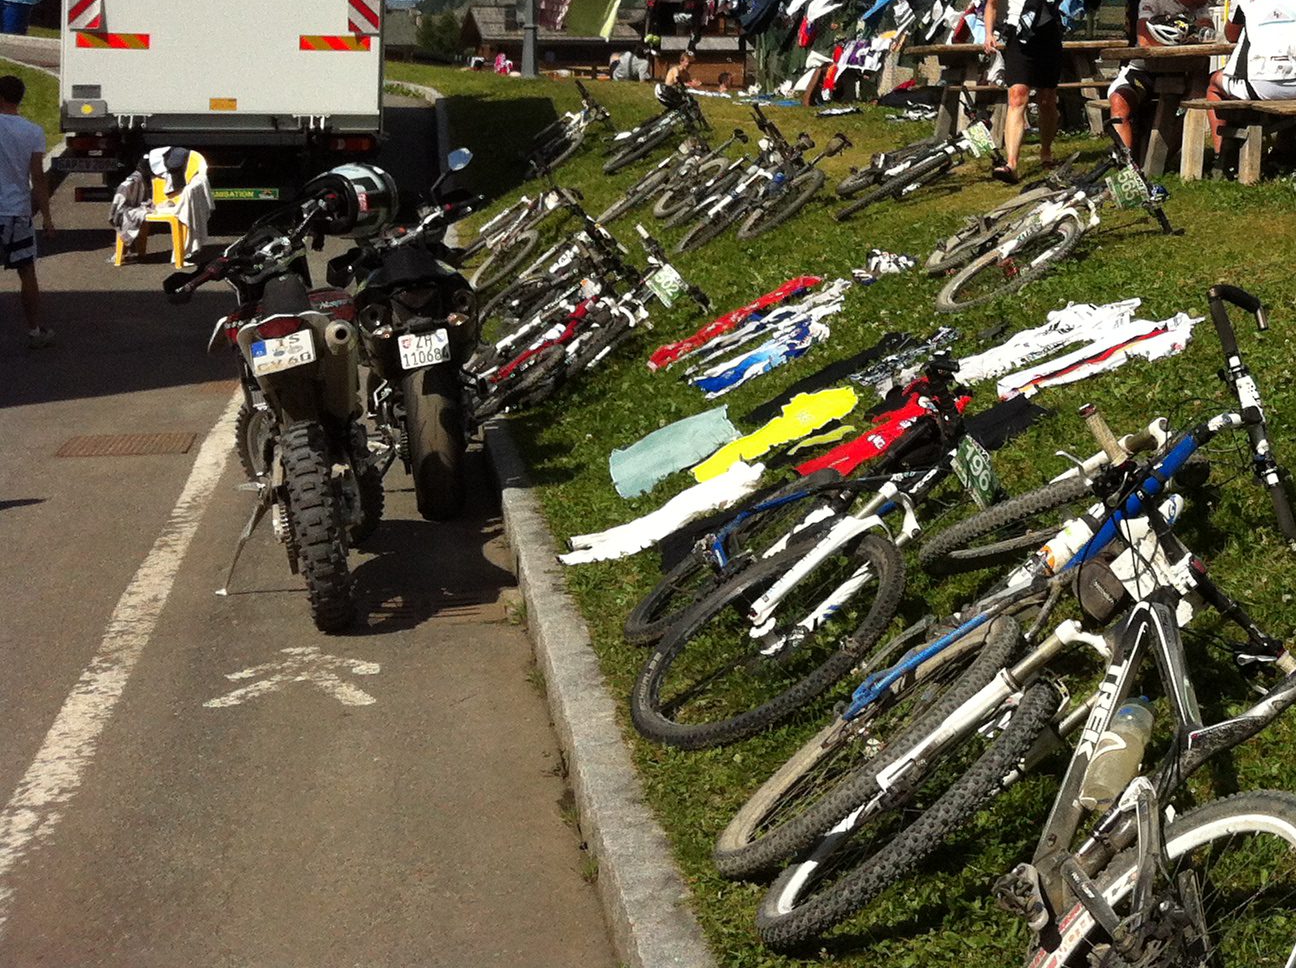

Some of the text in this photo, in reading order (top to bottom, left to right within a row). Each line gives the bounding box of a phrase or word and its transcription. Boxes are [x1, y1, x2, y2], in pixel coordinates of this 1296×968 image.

[1118, 170, 1140, 201] 565
[416, 334, 433, 349] ZH
[965, 444, 992, 491] 196
[1077, 658, 1129, 762] TREK
